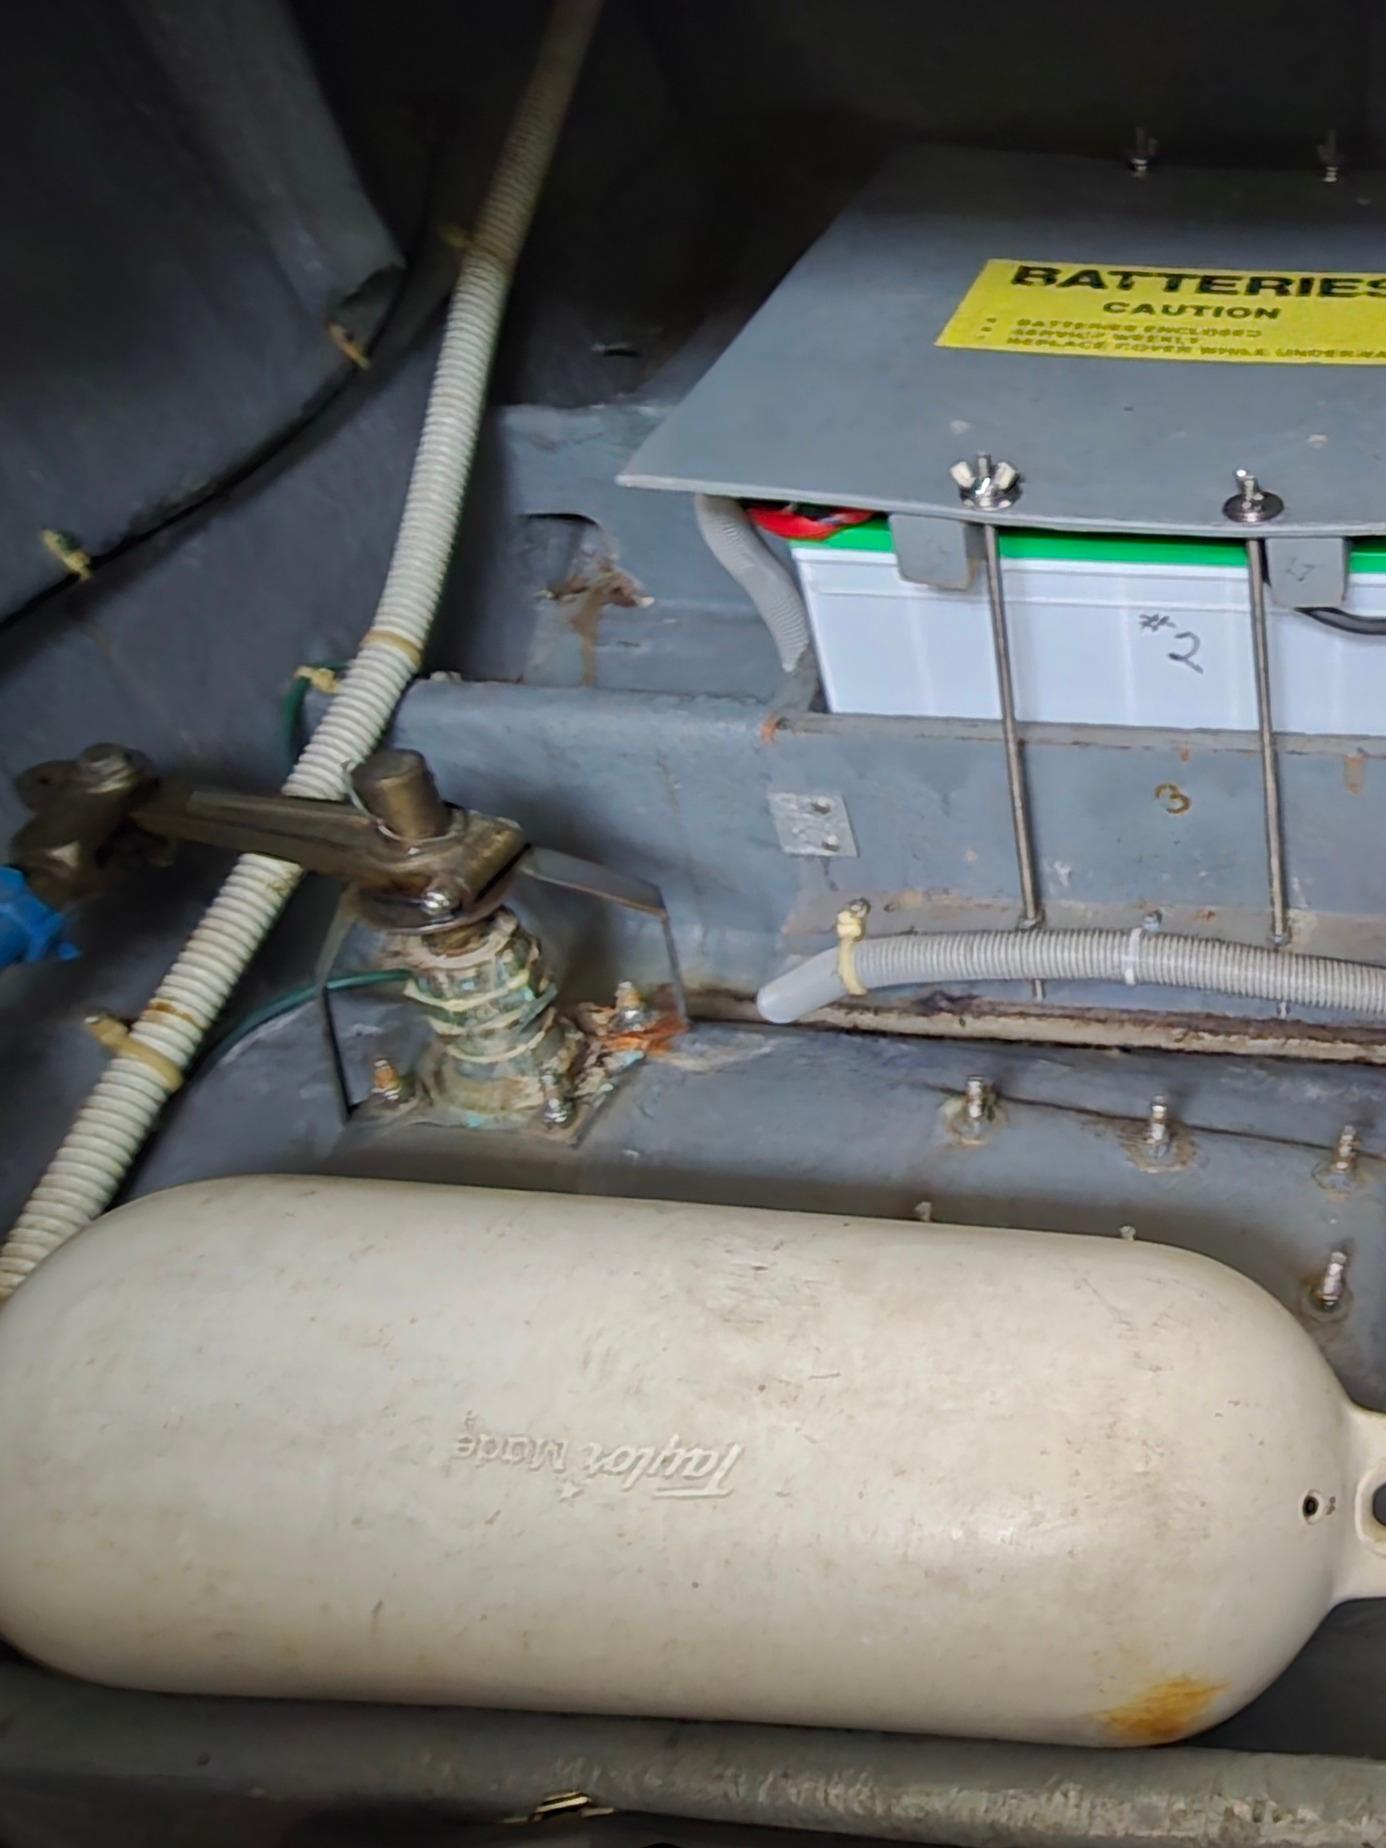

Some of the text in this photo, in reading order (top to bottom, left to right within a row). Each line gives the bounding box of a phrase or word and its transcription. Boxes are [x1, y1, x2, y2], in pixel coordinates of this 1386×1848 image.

[1103, 301, 1281, 320] CAUTION
[453, 1431, 745, 1499] Taylor Made
